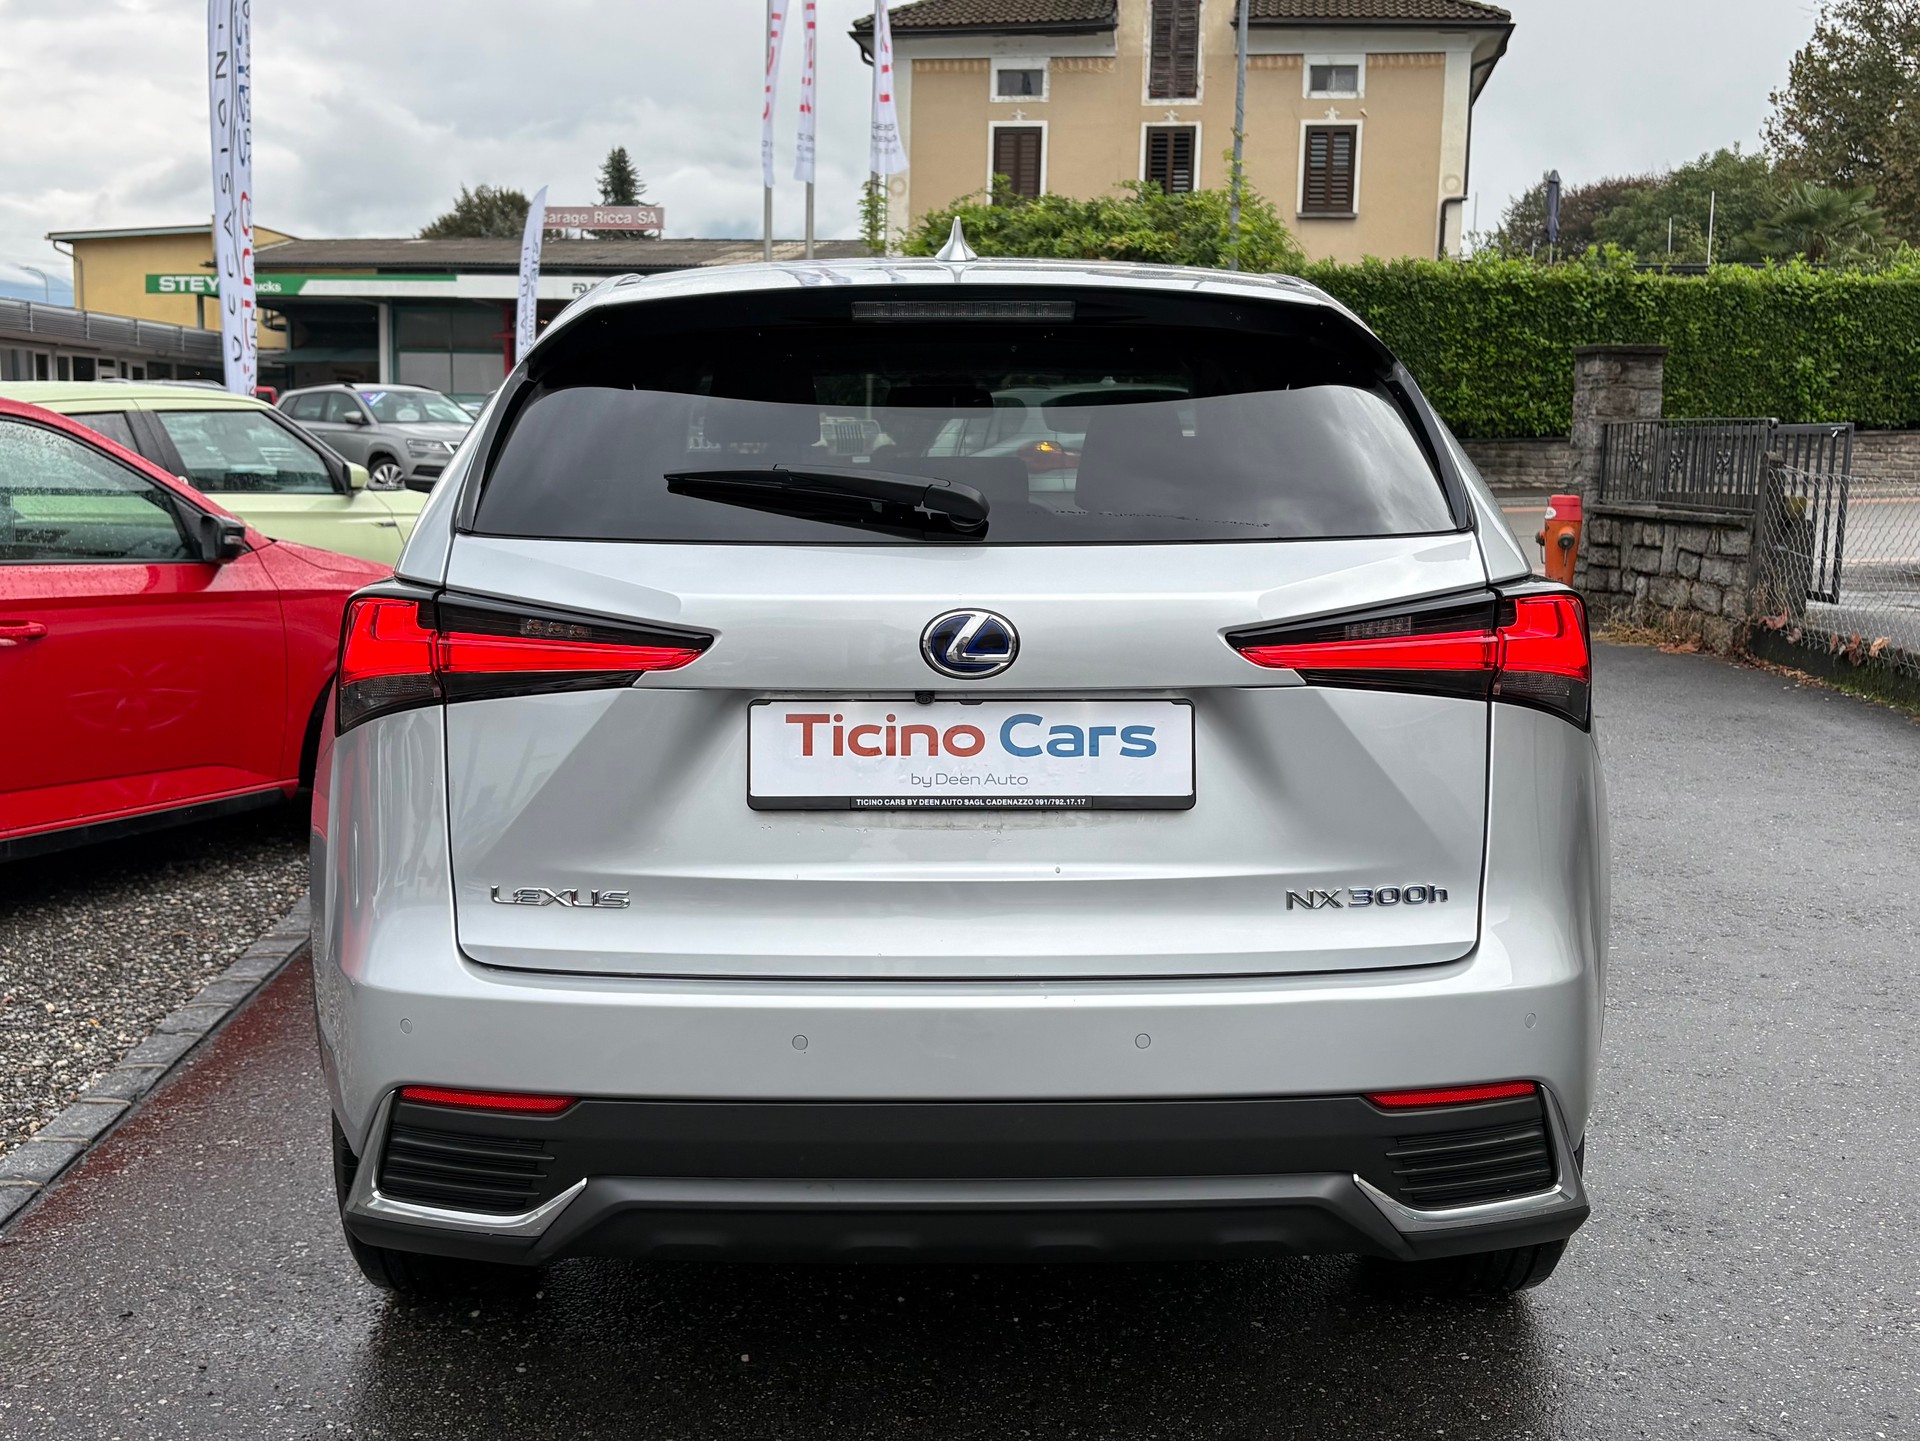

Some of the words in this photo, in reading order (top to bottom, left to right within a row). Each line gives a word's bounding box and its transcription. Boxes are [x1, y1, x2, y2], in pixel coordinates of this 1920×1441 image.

[593, 210, 632, 225] Ricca
[637, 210, 658, 225] SA
[785, 713, 986, 757] Ticino
[999, 713, 1158, 758] Cars
[910, 772, 933, 788] by
[935, 772, 981, 785] Deen
[984, 772, 1029, 786] Auto
[856, 798, 883, 807] TICINO
[884, 798, 906, 807] CARS
[907, 798, 919, 807] BY
[919, 798, 940, 807] DEEN
[941, 798, 963, 807] AUTO
[964, 798, 985, 807] SAGL
[986, 798, 1034, 807] CADENAZZO
[1035, 798, 1086, 807] 091/792.17.17
[490, 885, 631, 909] LEXUS
[1285, 887, 1344, 911] NX
[1348, 882, 1449, 908] 300h
